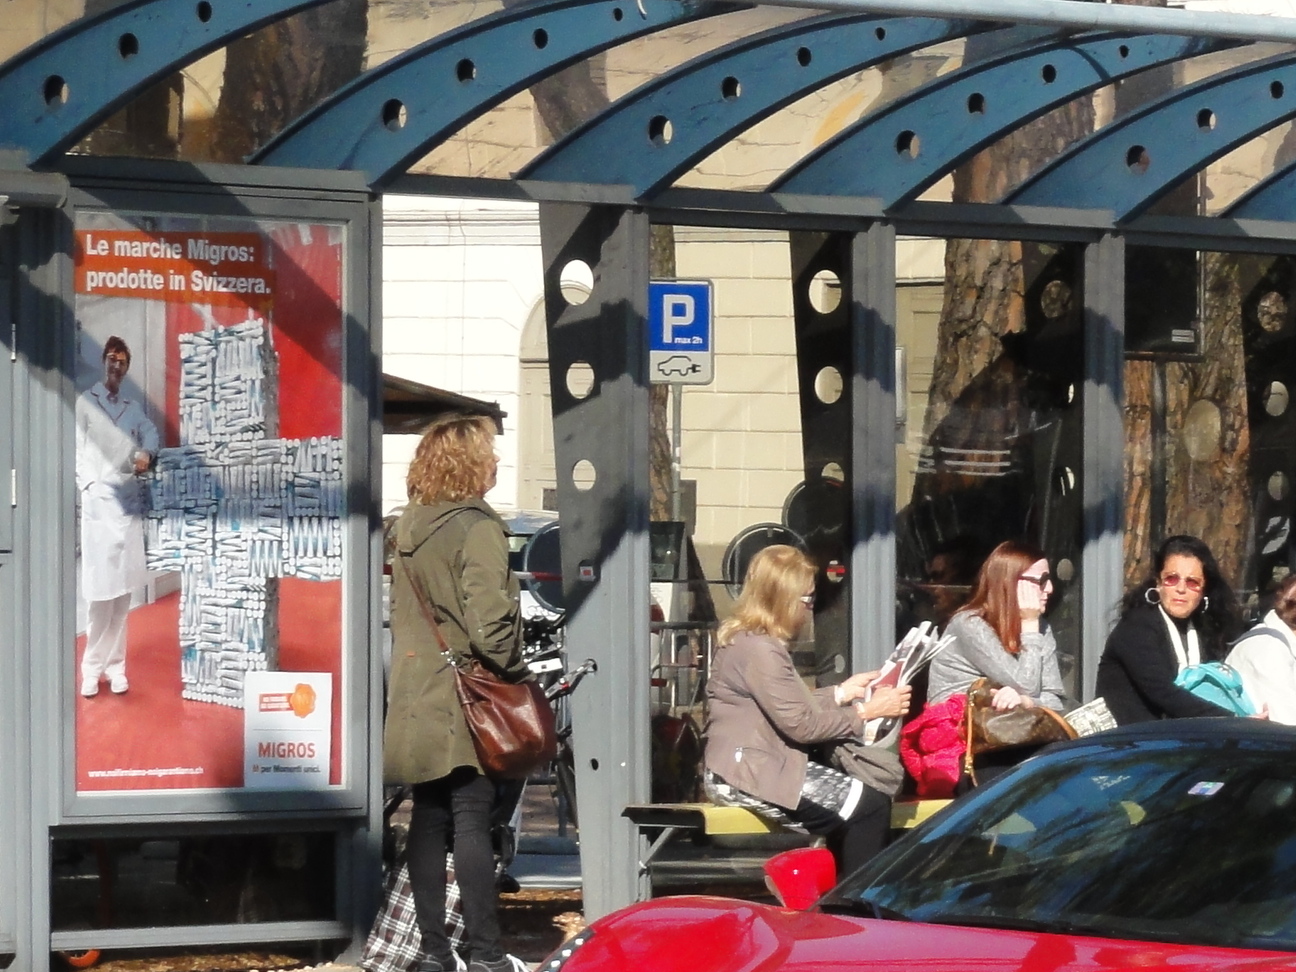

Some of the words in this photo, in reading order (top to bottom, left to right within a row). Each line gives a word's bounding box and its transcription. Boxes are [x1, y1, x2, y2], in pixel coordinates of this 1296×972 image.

[86, 234, 109, 256] Le
[114, 238, 182, 259] marche
[187, 238, 254, 265] Migros:
[86, 267, 165, 291] prodotte
[169, 269, 186, 291] in
[190, 269, 271, 294] Svizzera.
[663, 293, 695, 343] P
[258, 742, 316, 758] MIGROS
